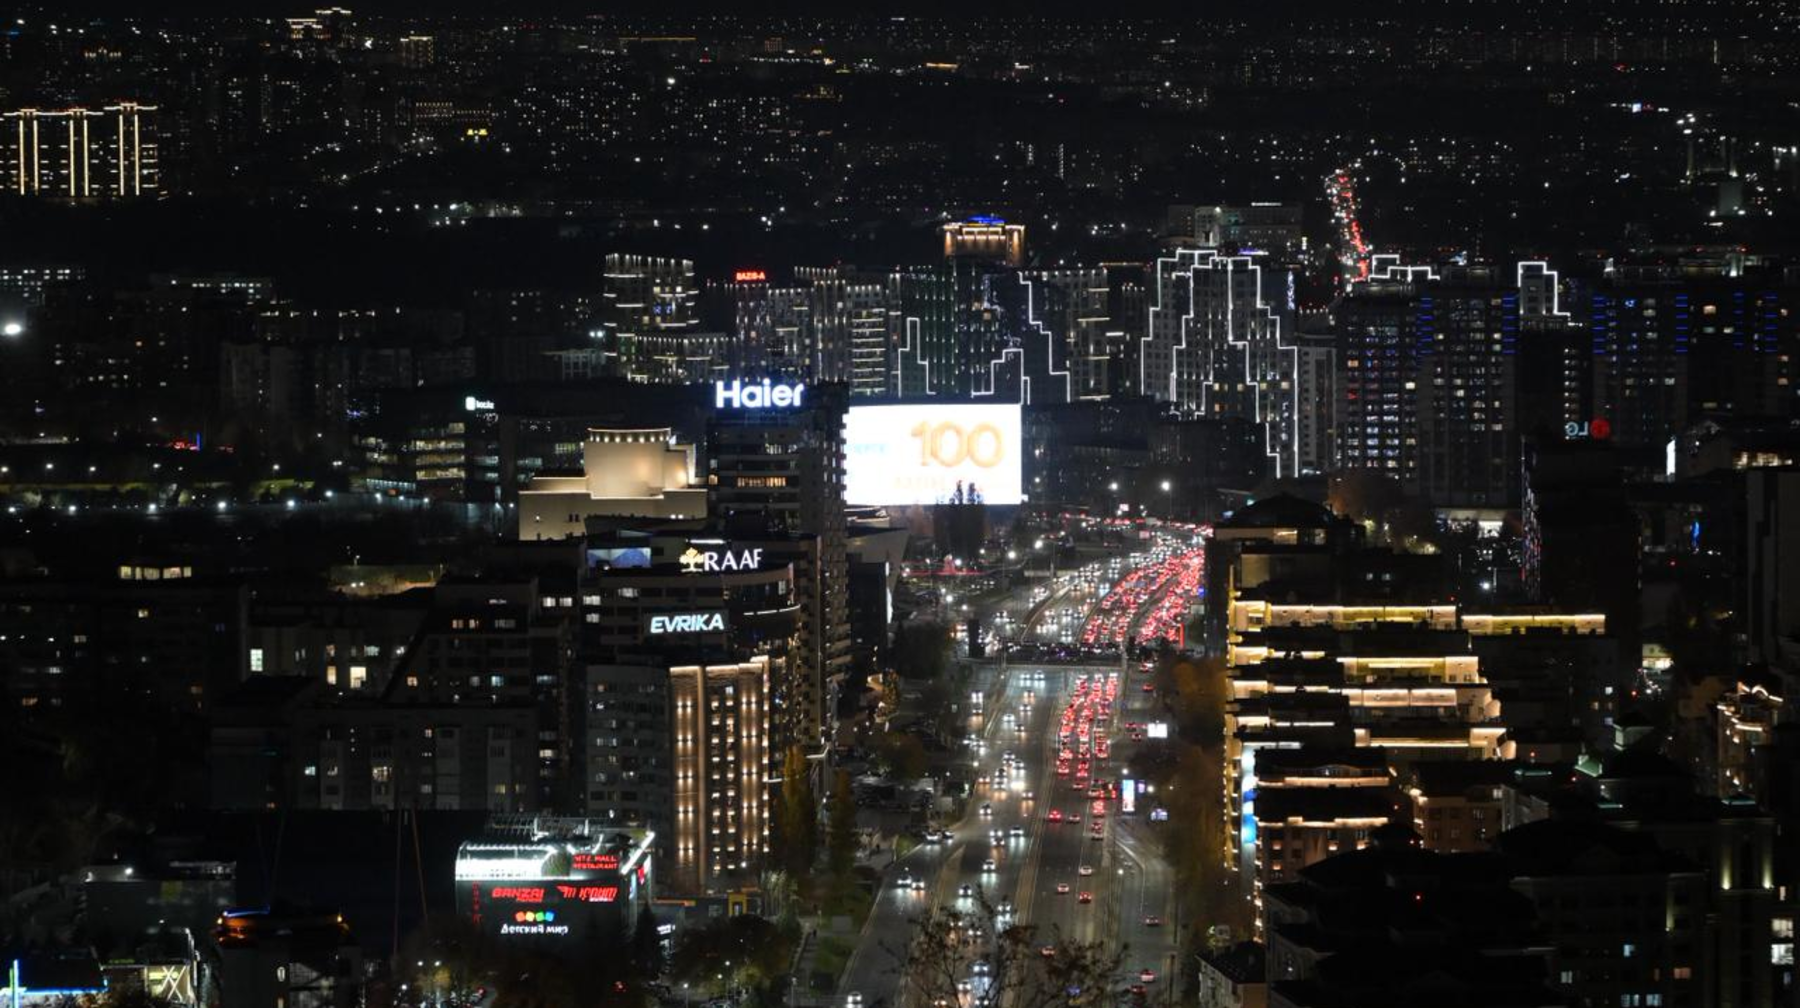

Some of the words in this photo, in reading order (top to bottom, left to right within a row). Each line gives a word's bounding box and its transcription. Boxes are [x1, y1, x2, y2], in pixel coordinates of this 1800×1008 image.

[716, 378, 804, 408] Haier
[910, 420, 1004, 468] 100
[703, 549, 763, 572] RAAF
[650, 613, 725, 634] EVRIKA
[491, 887, 545, 900] BANZAI
[500, 923, 544, 934] Детский
[546, 925, 569, 936] мир
